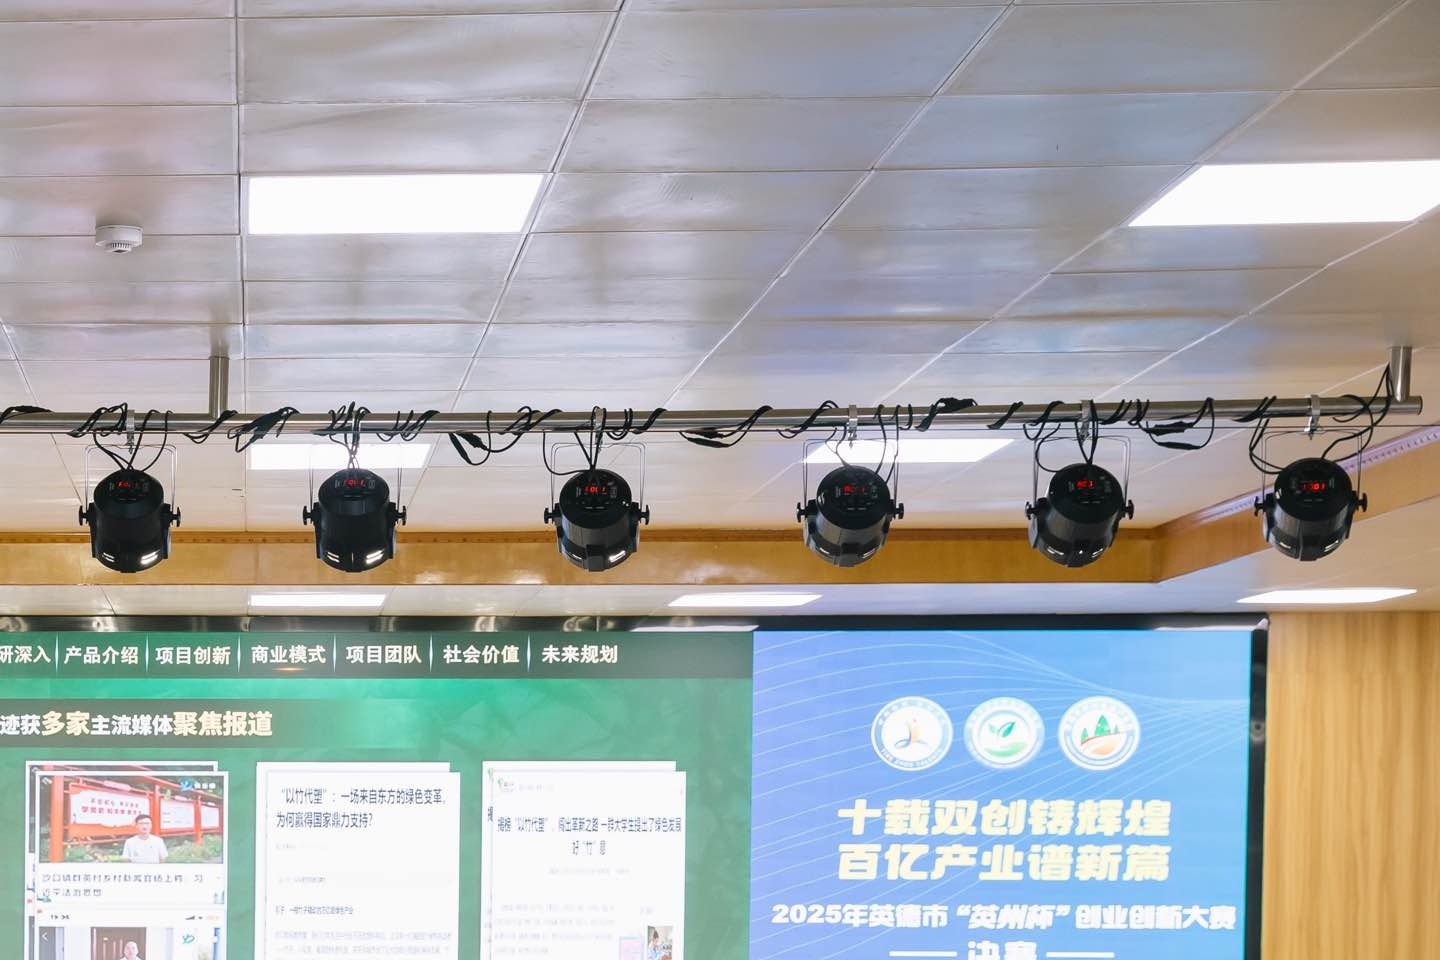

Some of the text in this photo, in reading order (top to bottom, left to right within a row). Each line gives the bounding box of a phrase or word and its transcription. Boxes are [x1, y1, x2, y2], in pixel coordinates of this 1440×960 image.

[64, 645, 140, 666] 产品介绍
[155, 645, 232, 666] 项目创新
[250, 645, 327, 665] 商业模式
[345, 645, 423, 665] 项目团队
[442, 645, 520, 665] 社会价值
[541, 645, 619, 665] 未来规划
[836, 798, 1172, 837] 十载双创铸辉煌
[836, 842, 1172, 882] 百亿产业谱新篇
